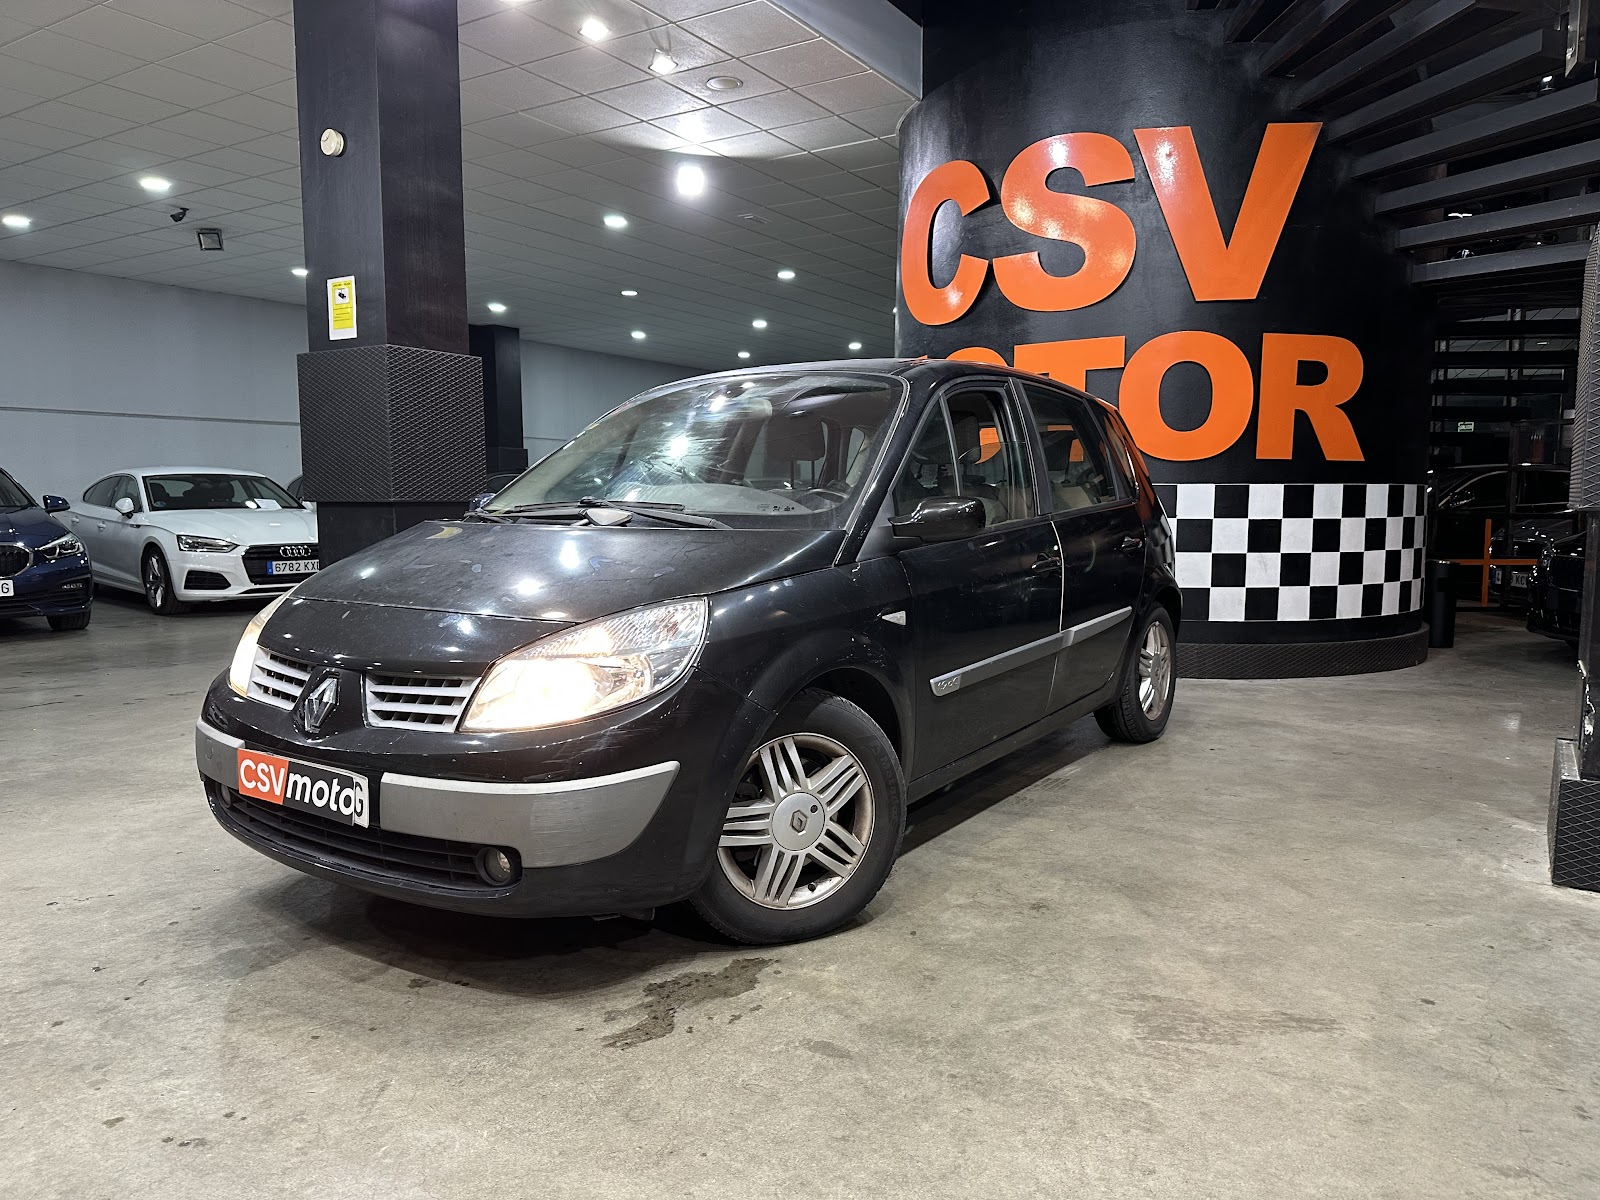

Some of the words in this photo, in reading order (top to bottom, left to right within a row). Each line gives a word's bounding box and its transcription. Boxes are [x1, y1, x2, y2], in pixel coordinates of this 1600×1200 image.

[899, 121, 1323, 326] CSV
[916, 330, 1365, 462] TOR
[275, 562, 301, 572] 6782
